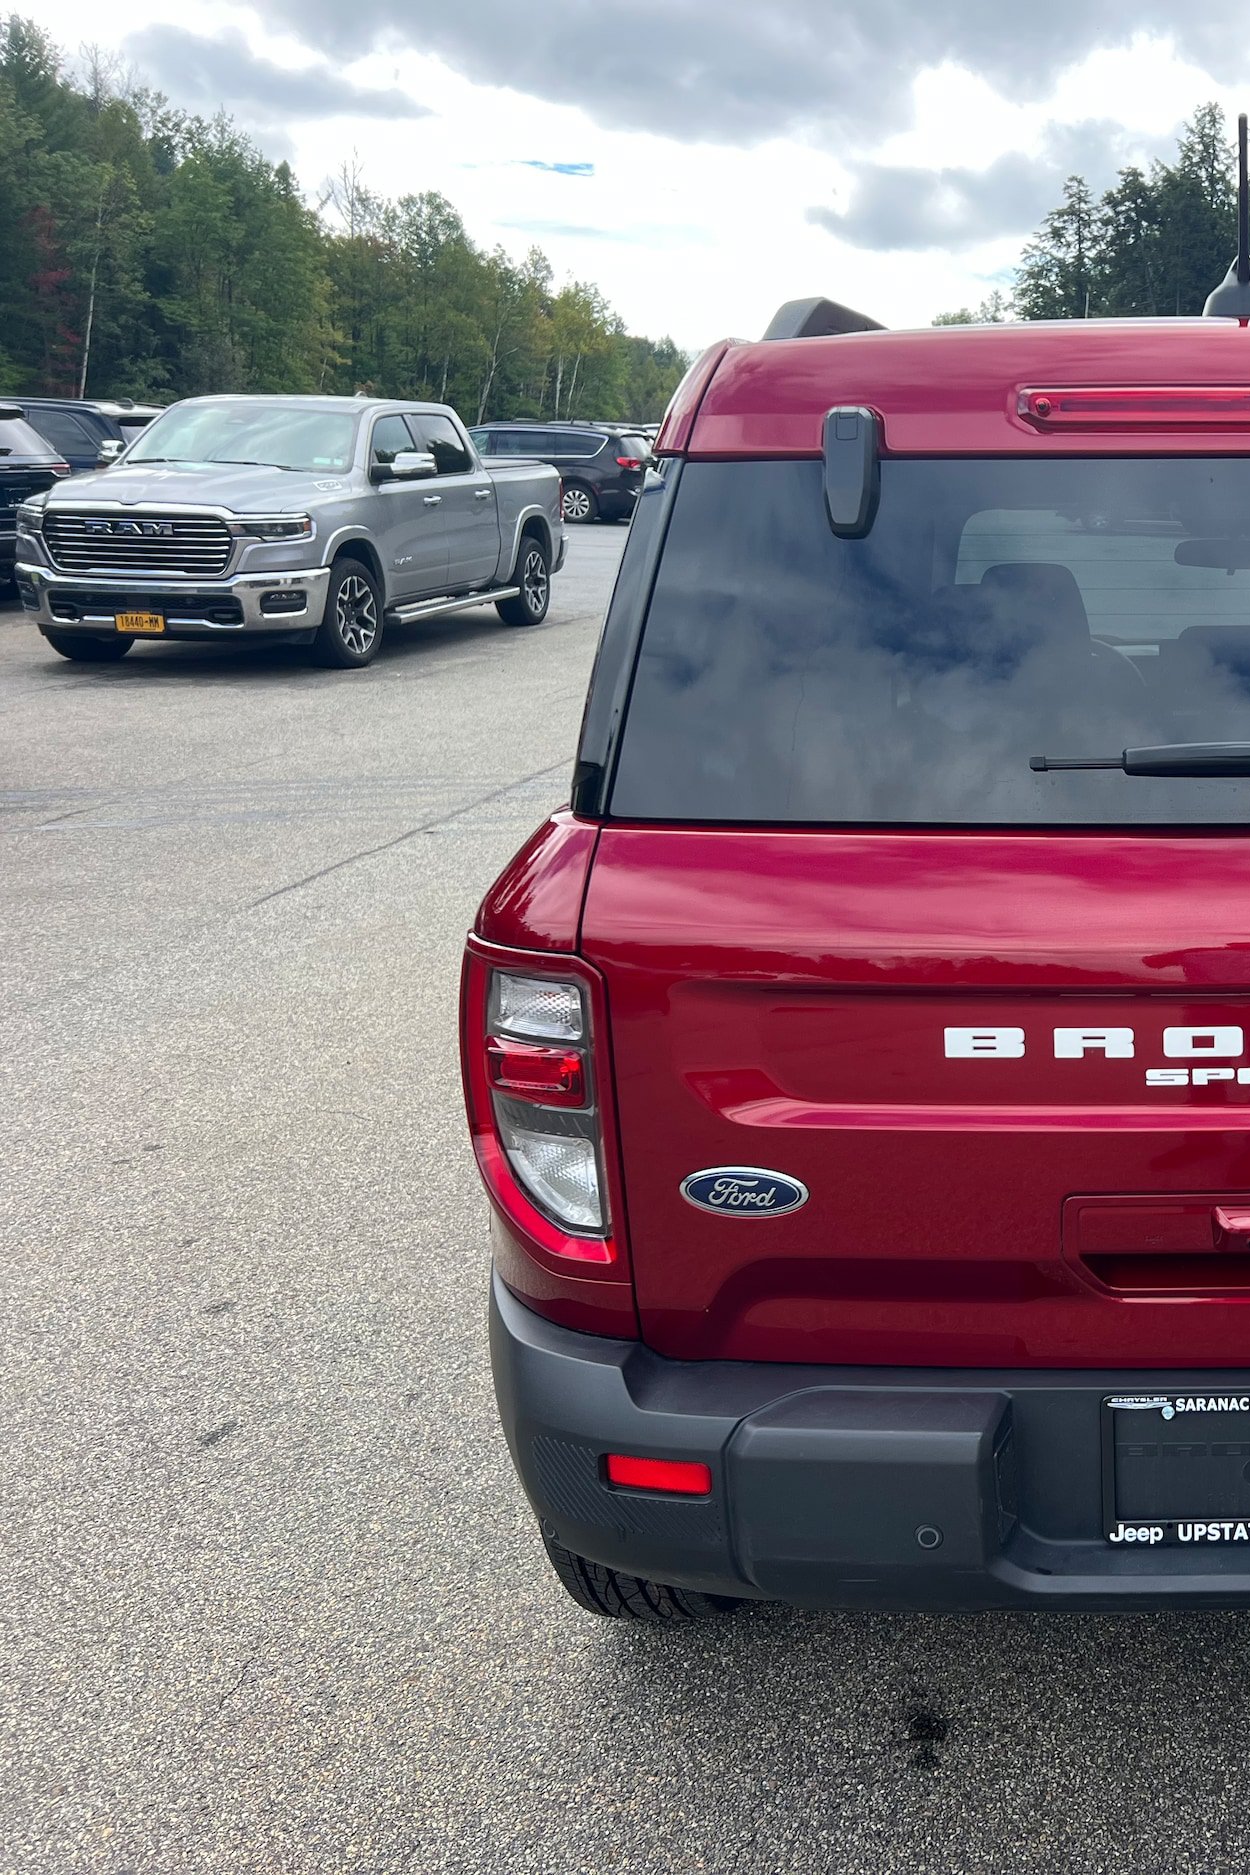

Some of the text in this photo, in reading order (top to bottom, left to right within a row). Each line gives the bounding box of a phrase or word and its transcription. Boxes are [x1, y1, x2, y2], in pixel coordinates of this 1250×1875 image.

[84, 520, 174, 536] RAM
[708, 1177, 777, 1207] Ford
[1175, 1397, 1250, 1412] SARANAC
[1109, 1523, 1164, 1544] Jeep
